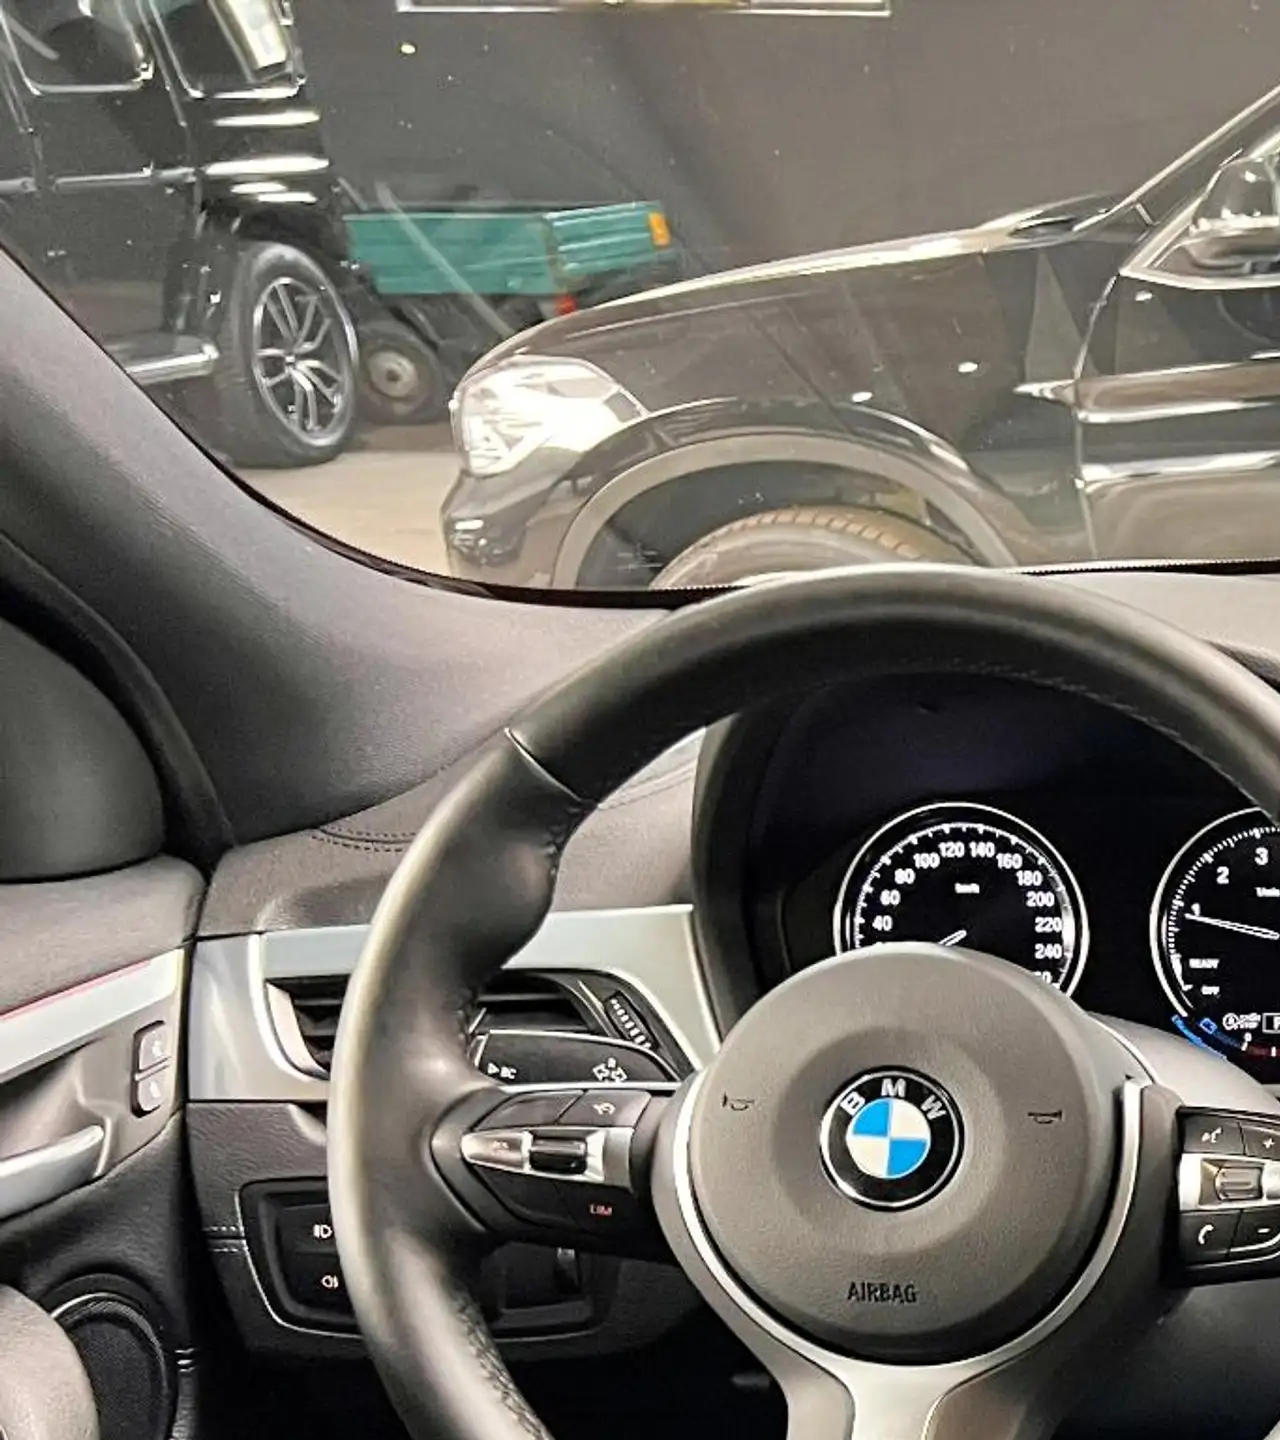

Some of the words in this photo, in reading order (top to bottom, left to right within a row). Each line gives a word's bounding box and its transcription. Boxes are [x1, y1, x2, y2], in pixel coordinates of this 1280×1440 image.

[938, 842, 965, 858] 120
[969, 842, 995, 858] 140
[1254, 847, 1268, 866] 3
[913, 853, 940, 869] 100
[996, 853, 1023, 869] 160
[894, 868, 915, 884] 80
[1016, 870, 1042, 886] 180
[1216, 866, 1229, 885] 2
[880, 890, 901, 906] 60
[1026, 892, 1054, 907] 200
[1191, 903, 1200, 916] 1
[872, 915, 893, 931] 40
[1035, 917, 1062, 933] 220
[1035, 944, 1062, 960] 240
[840, 1078, 946, 1120] BMW
[848, 1282, 918, 1303] AIRBAG
